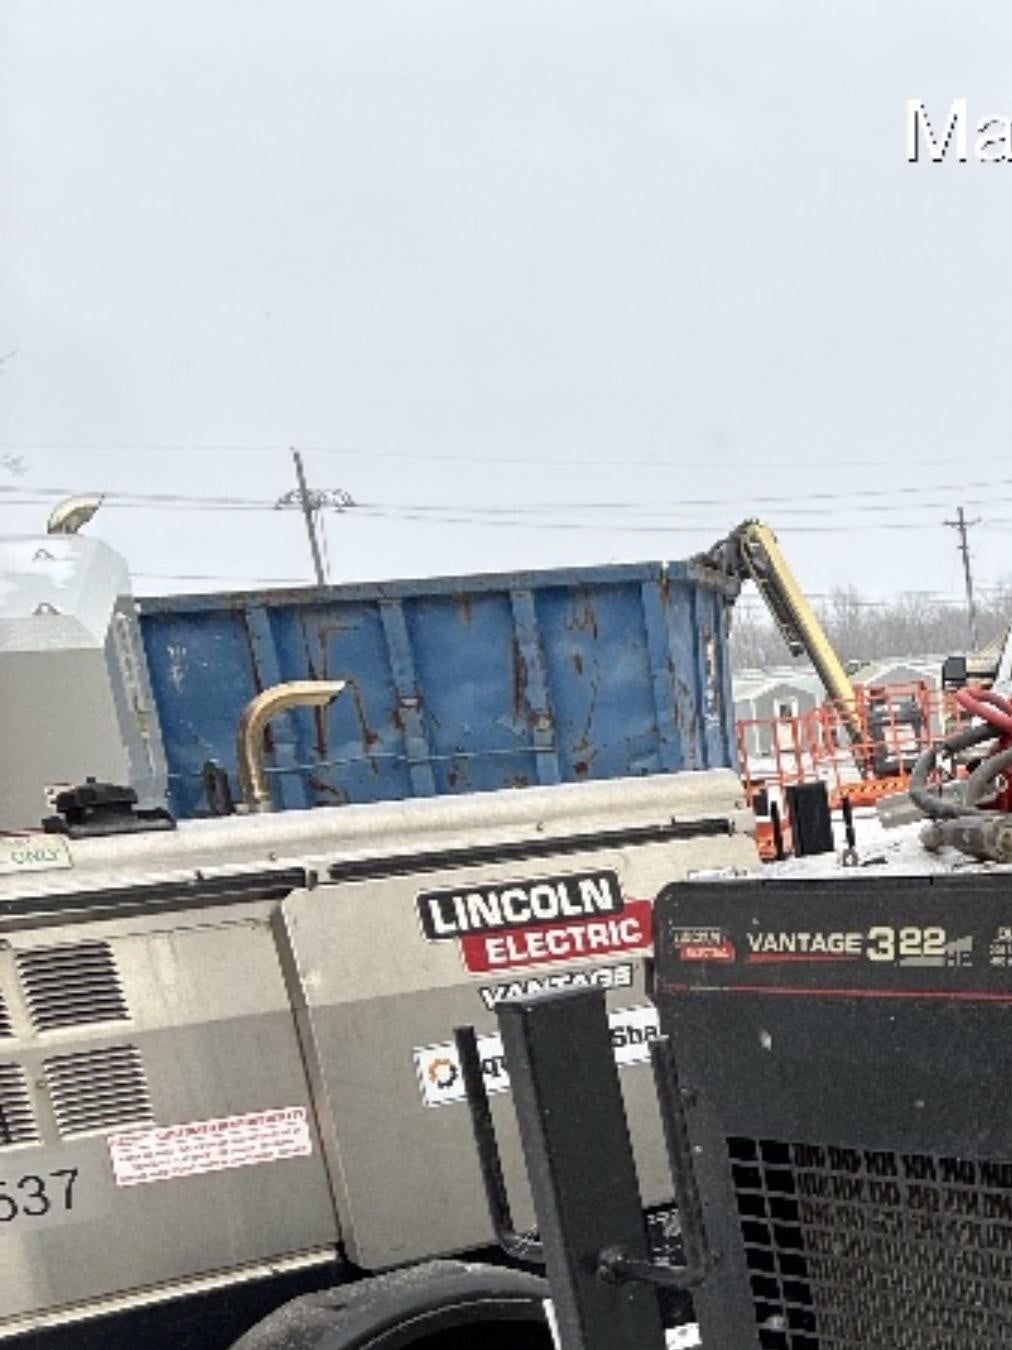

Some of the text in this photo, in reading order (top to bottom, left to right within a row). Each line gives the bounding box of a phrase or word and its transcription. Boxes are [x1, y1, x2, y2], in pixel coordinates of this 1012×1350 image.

[428, 878, 615, 934] LINCOLN
[485, 917, 641, 964] ELECTRIC
[747, 931, 863, 953] VANTAGE
[866, 926, 945, 961] 322
